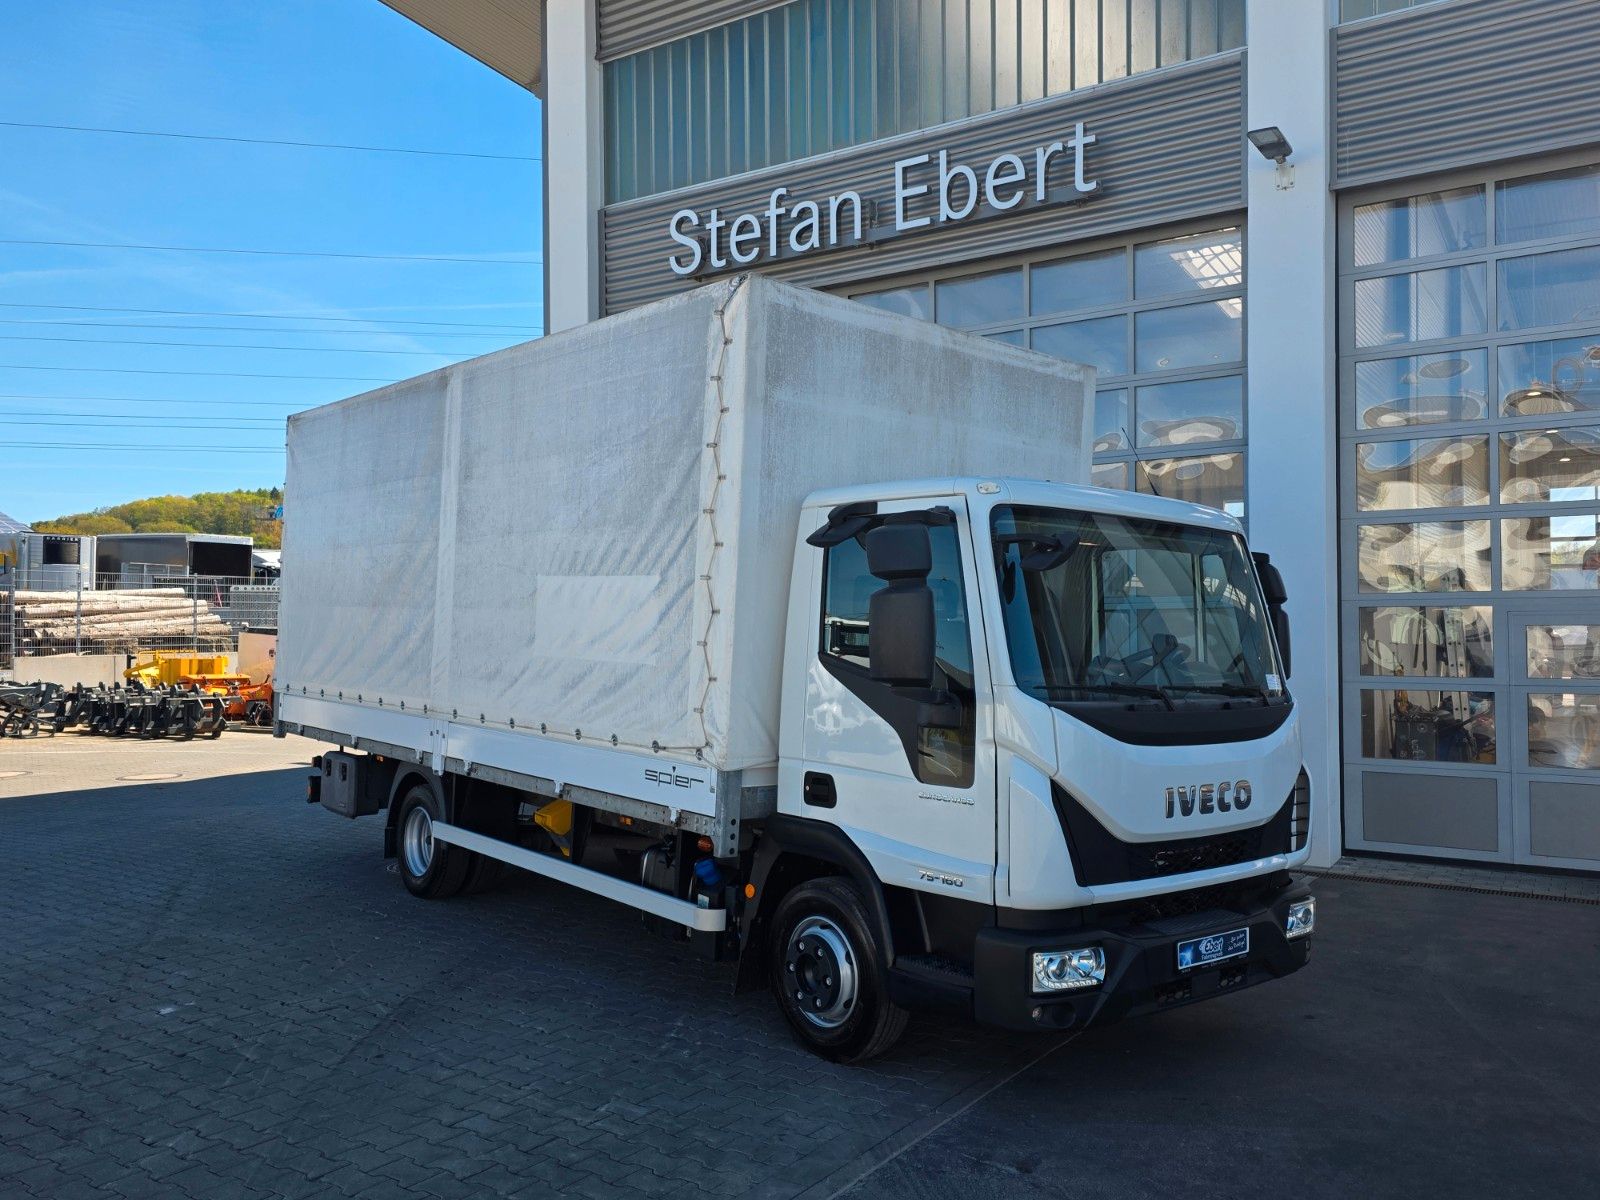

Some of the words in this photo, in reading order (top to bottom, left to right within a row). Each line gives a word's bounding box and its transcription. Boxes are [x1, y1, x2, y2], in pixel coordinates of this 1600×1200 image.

[669, 187, 862, 275] Stefan
[894, 122, 1098, 231] Ebert
[645, 766, 704, 789] spier
[1165, 779, 1252, 819] IVECO
[919, 870, 963, 887] 75-160
